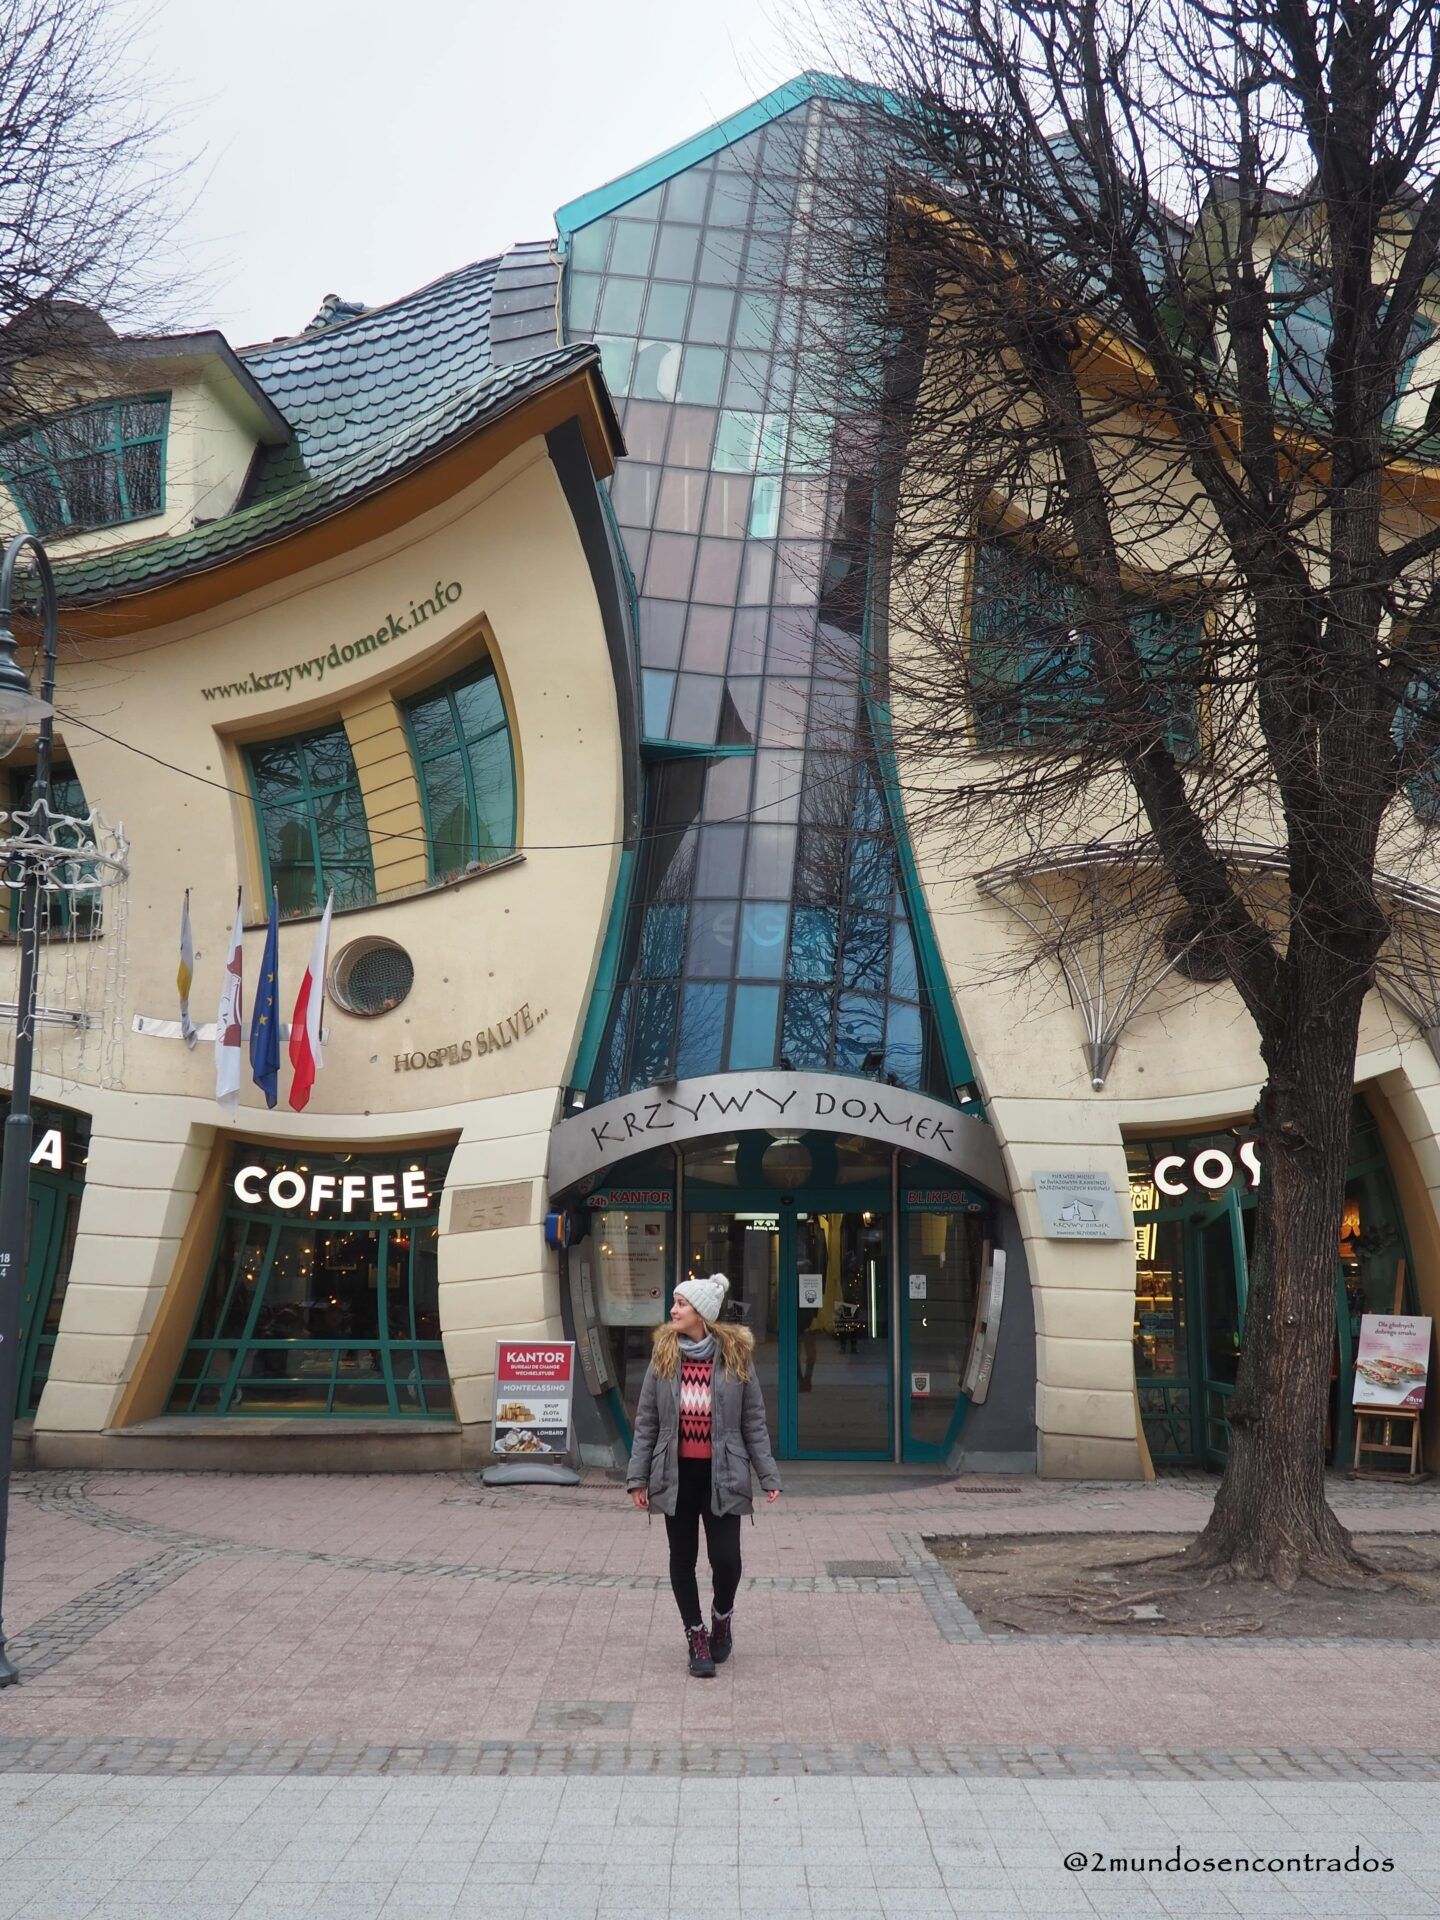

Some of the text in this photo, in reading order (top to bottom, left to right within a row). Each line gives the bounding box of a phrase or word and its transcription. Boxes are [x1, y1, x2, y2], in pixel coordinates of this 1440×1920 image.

[201, 581, 463, 701] www.krzywydomek.info
[393, 1039, 472, 1073] HOSPES
[591, 1088, 954, 1152] KRZYWY DOMEK
[234, 1165, 429, 1213] COFFEE
[589, 1191, 671, 1206] 24h KANTOR
[907, 1191, 968, 1204] BLIKPOL
[506, 1351, 565, 1363] KANTOR
